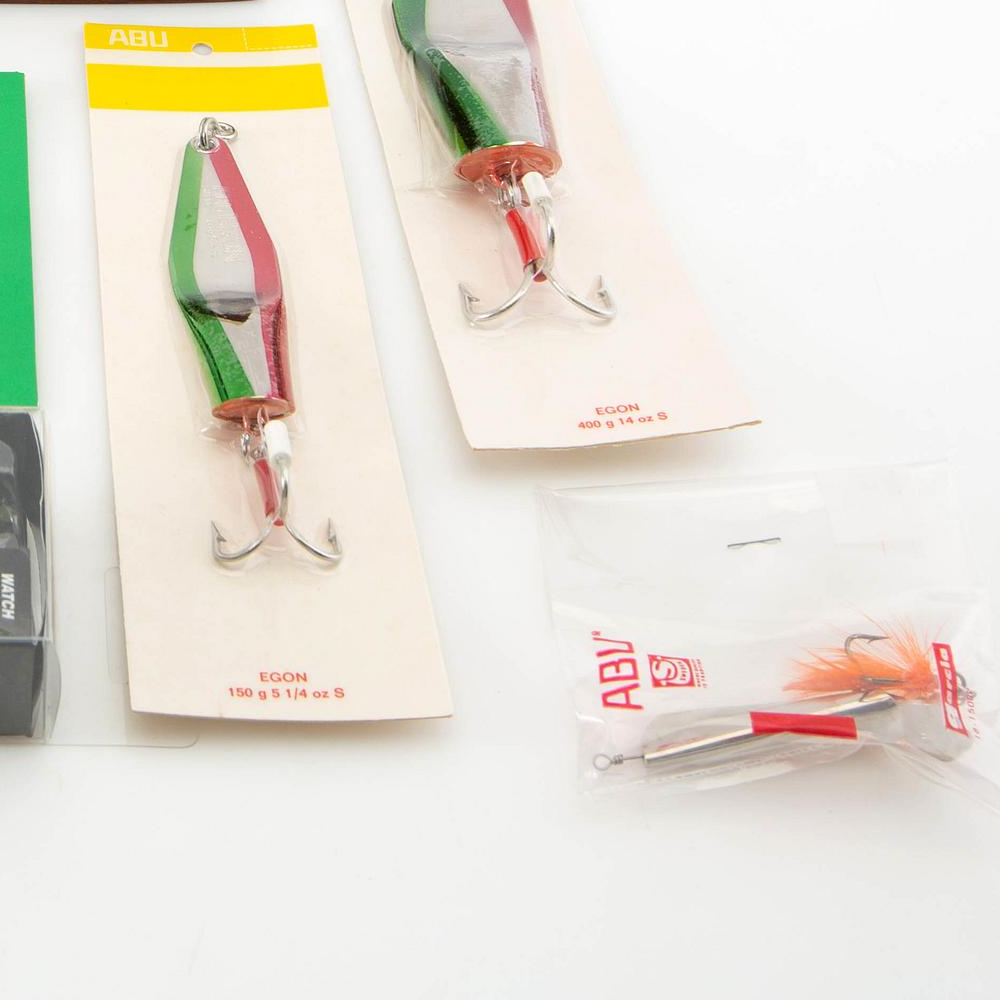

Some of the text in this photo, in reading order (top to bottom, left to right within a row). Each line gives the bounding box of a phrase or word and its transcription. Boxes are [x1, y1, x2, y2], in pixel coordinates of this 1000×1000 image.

[109, 29, 168, 47] ABU
[596, 403, 640, 416] EGON
[578, 411, 668, 429] 400 g 14 oz S
[1, 573, 15, 620] WATCH
[260, 671, 308, 682] EGON
[592, 637, 644, 710] ABU
[228, 687, 345, 700] 150 g 5 1/4 oz S
